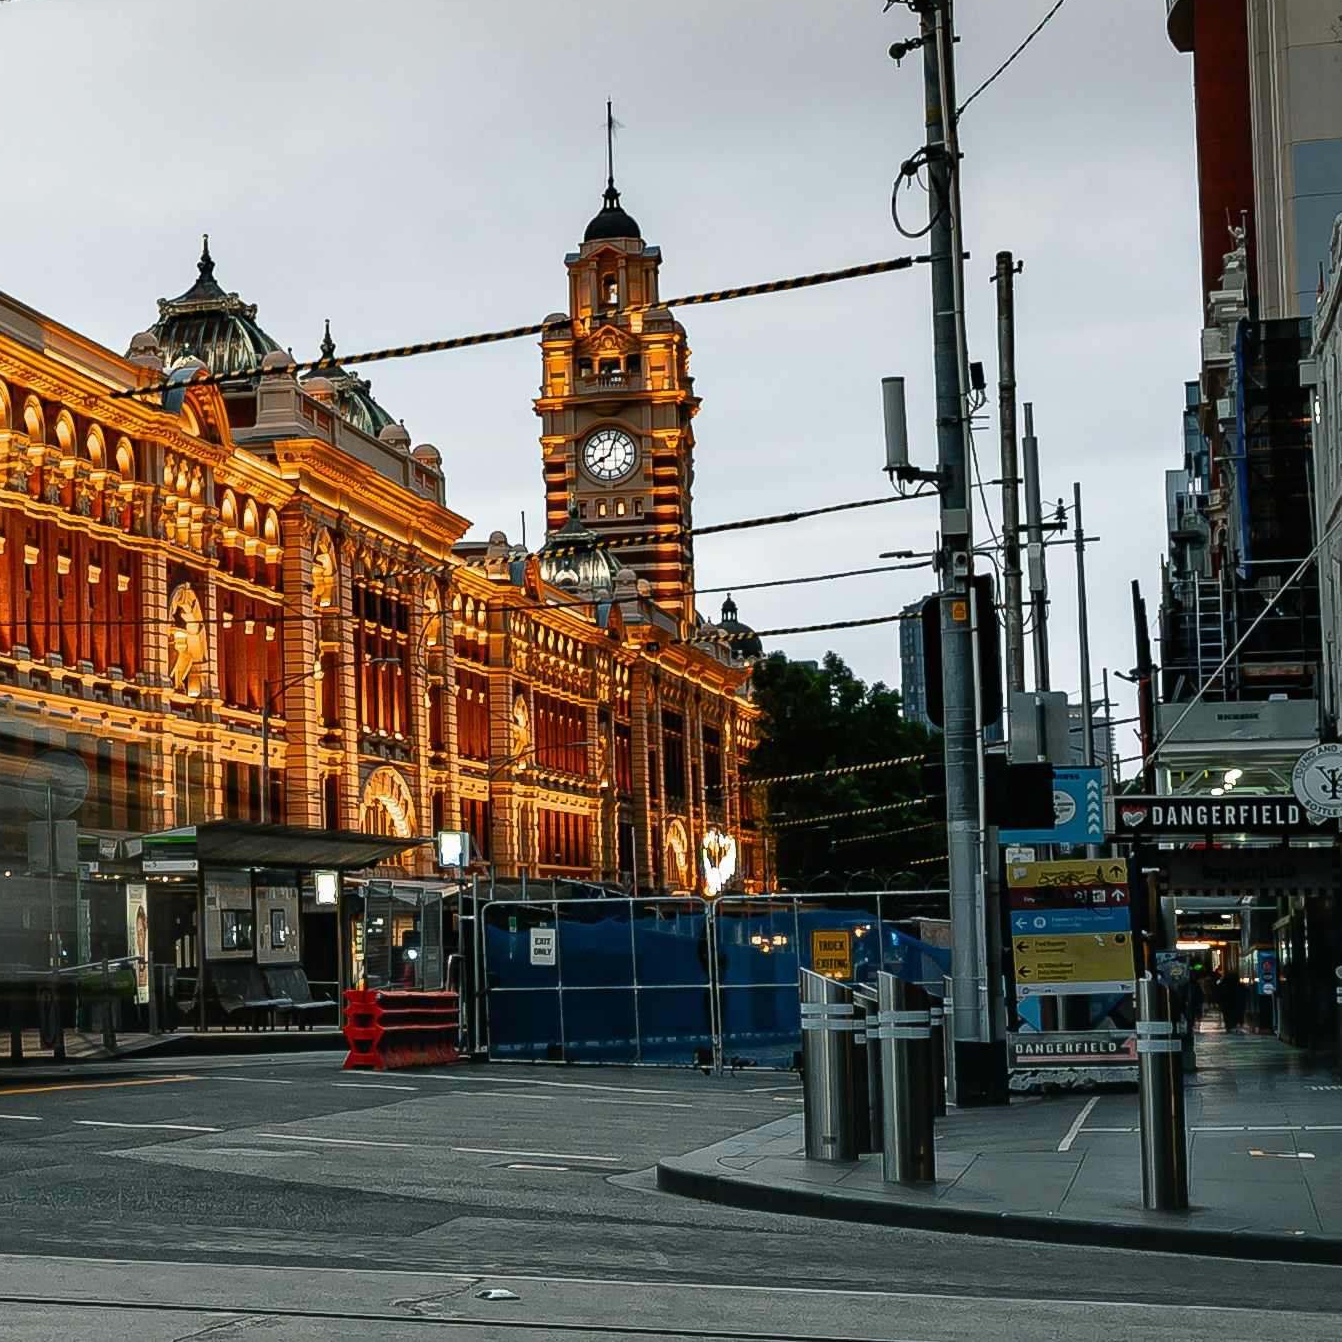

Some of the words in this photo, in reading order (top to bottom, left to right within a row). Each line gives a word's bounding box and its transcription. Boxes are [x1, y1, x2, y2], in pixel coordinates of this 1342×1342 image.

[1294, 750, 1316, 781] YOUNG
[1317, 744, 1338, 755] AND
[1303, 799, 1338, 816] BOTTLE
[1152, 805, 1300, 826] DANGERFIELD
[534, 937, 552, 946] EXIT
[818, 940, 846, 951] TRUCK
[533, 947, 553, 956] ONLY
[1015, 1043, 1117, 1054] DANGERFIELD
